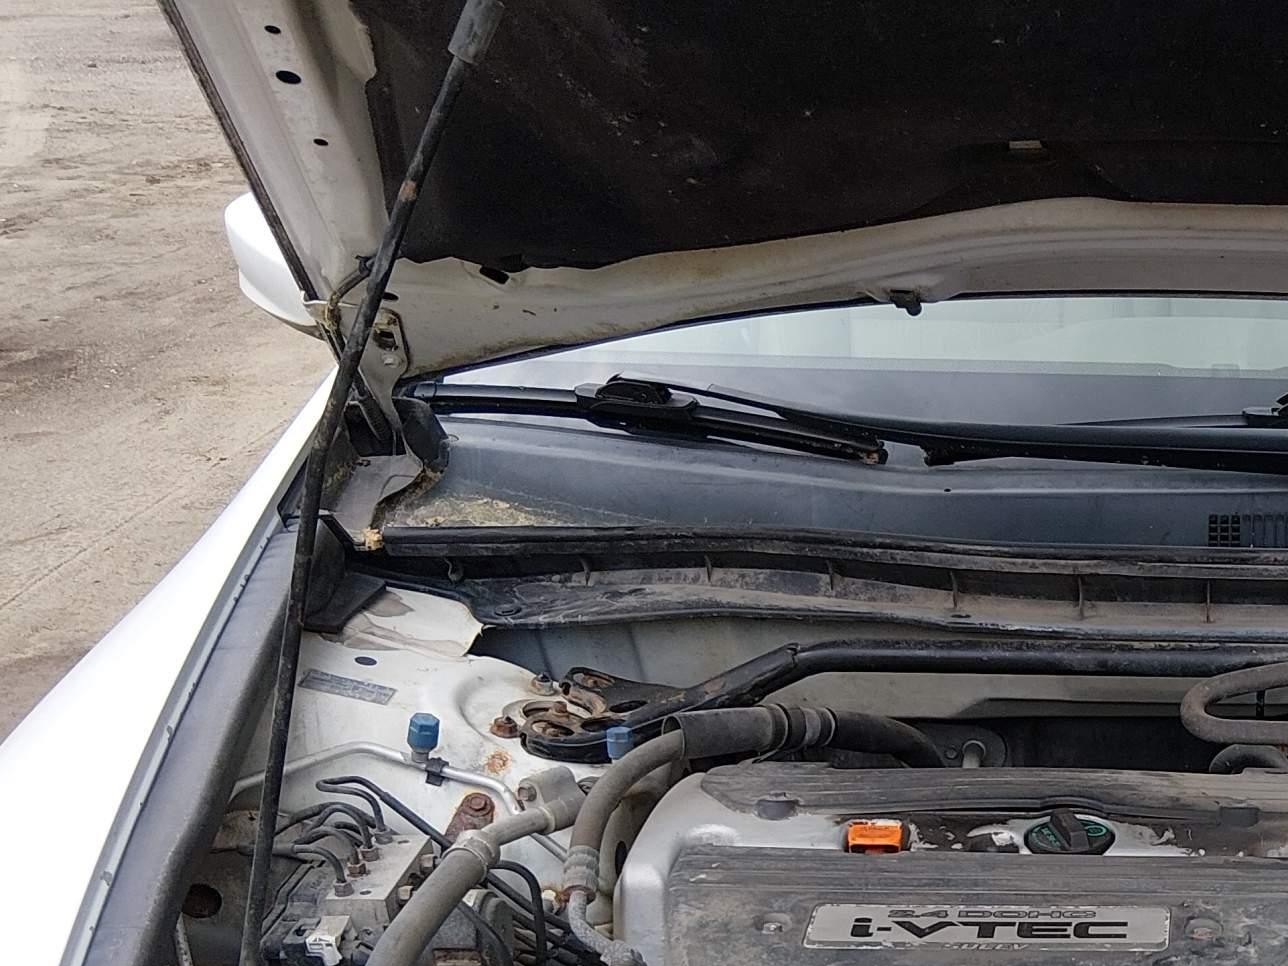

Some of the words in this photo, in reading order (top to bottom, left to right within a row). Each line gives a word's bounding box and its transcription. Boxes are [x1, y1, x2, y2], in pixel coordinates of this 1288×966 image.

[888, 909, 949, 919] 2.4
[957, 910, 1097, 919] DOHC
[850, 917, 1129, 939] i-VTEC
